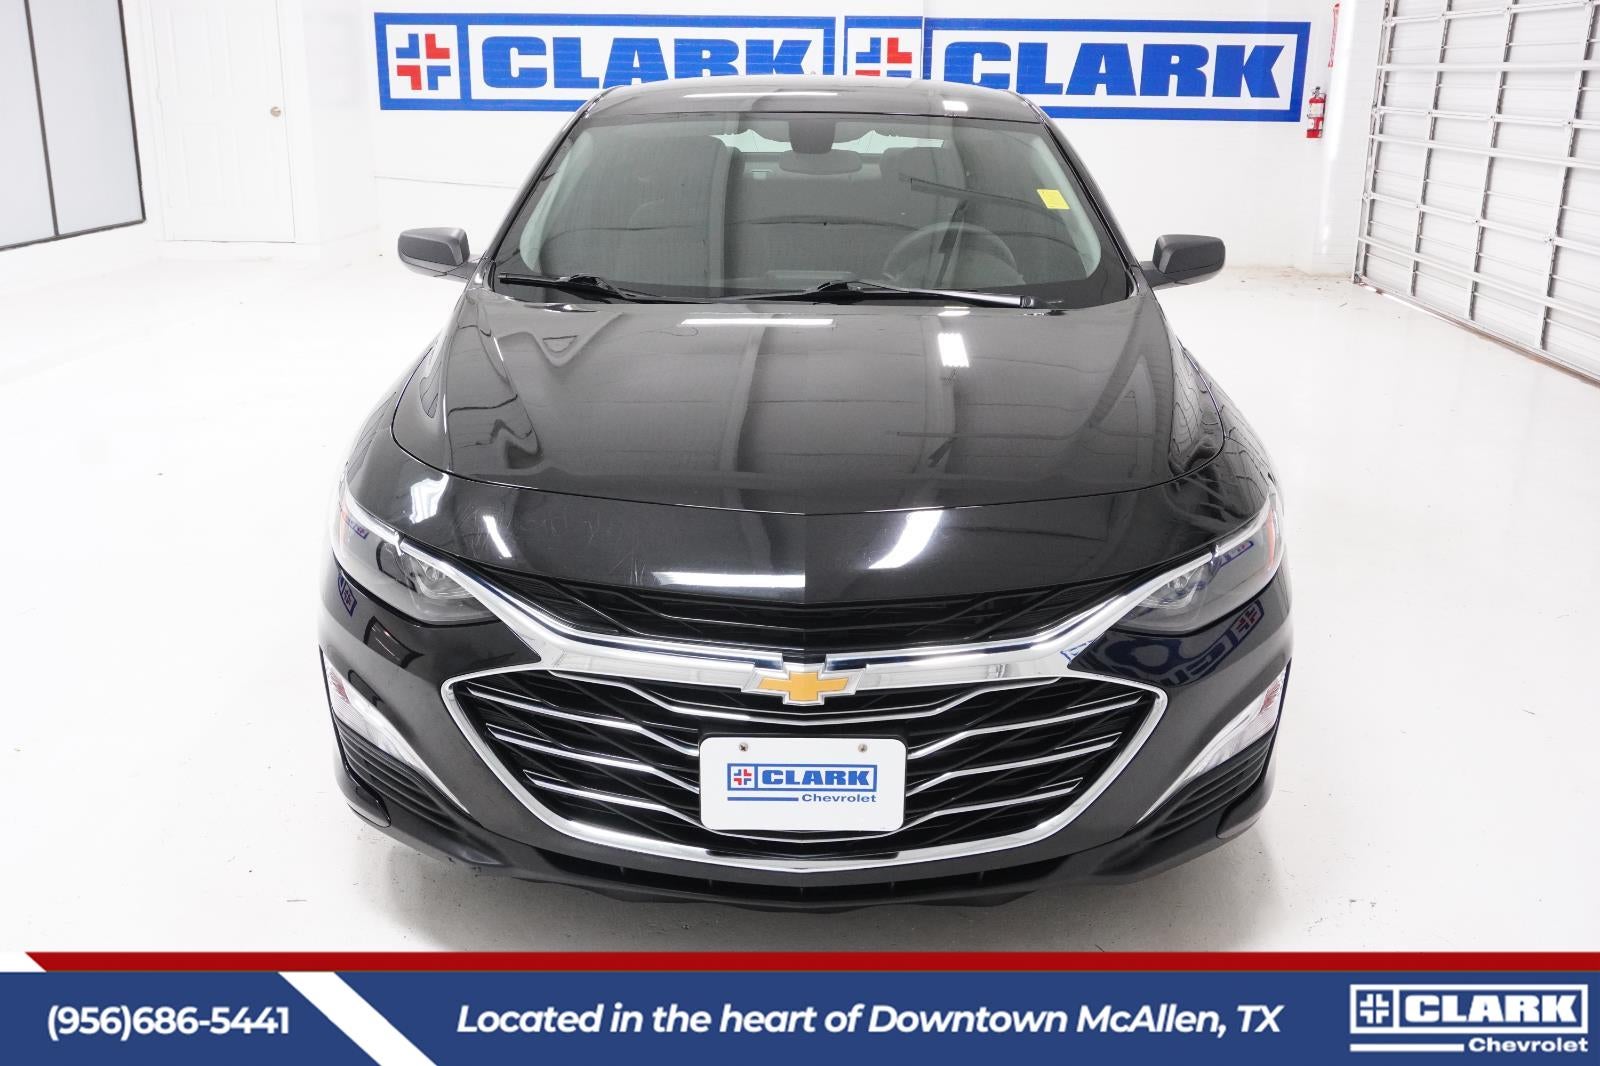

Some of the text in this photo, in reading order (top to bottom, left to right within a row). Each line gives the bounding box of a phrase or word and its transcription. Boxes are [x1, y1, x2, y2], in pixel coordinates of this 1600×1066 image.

[481, 35, 812, 89] CLARK
[944, 40, 1285, 98] CLARK
[762, 769, 870, 786] CLARK
[801, 793, 877, 803] Chevrolet
